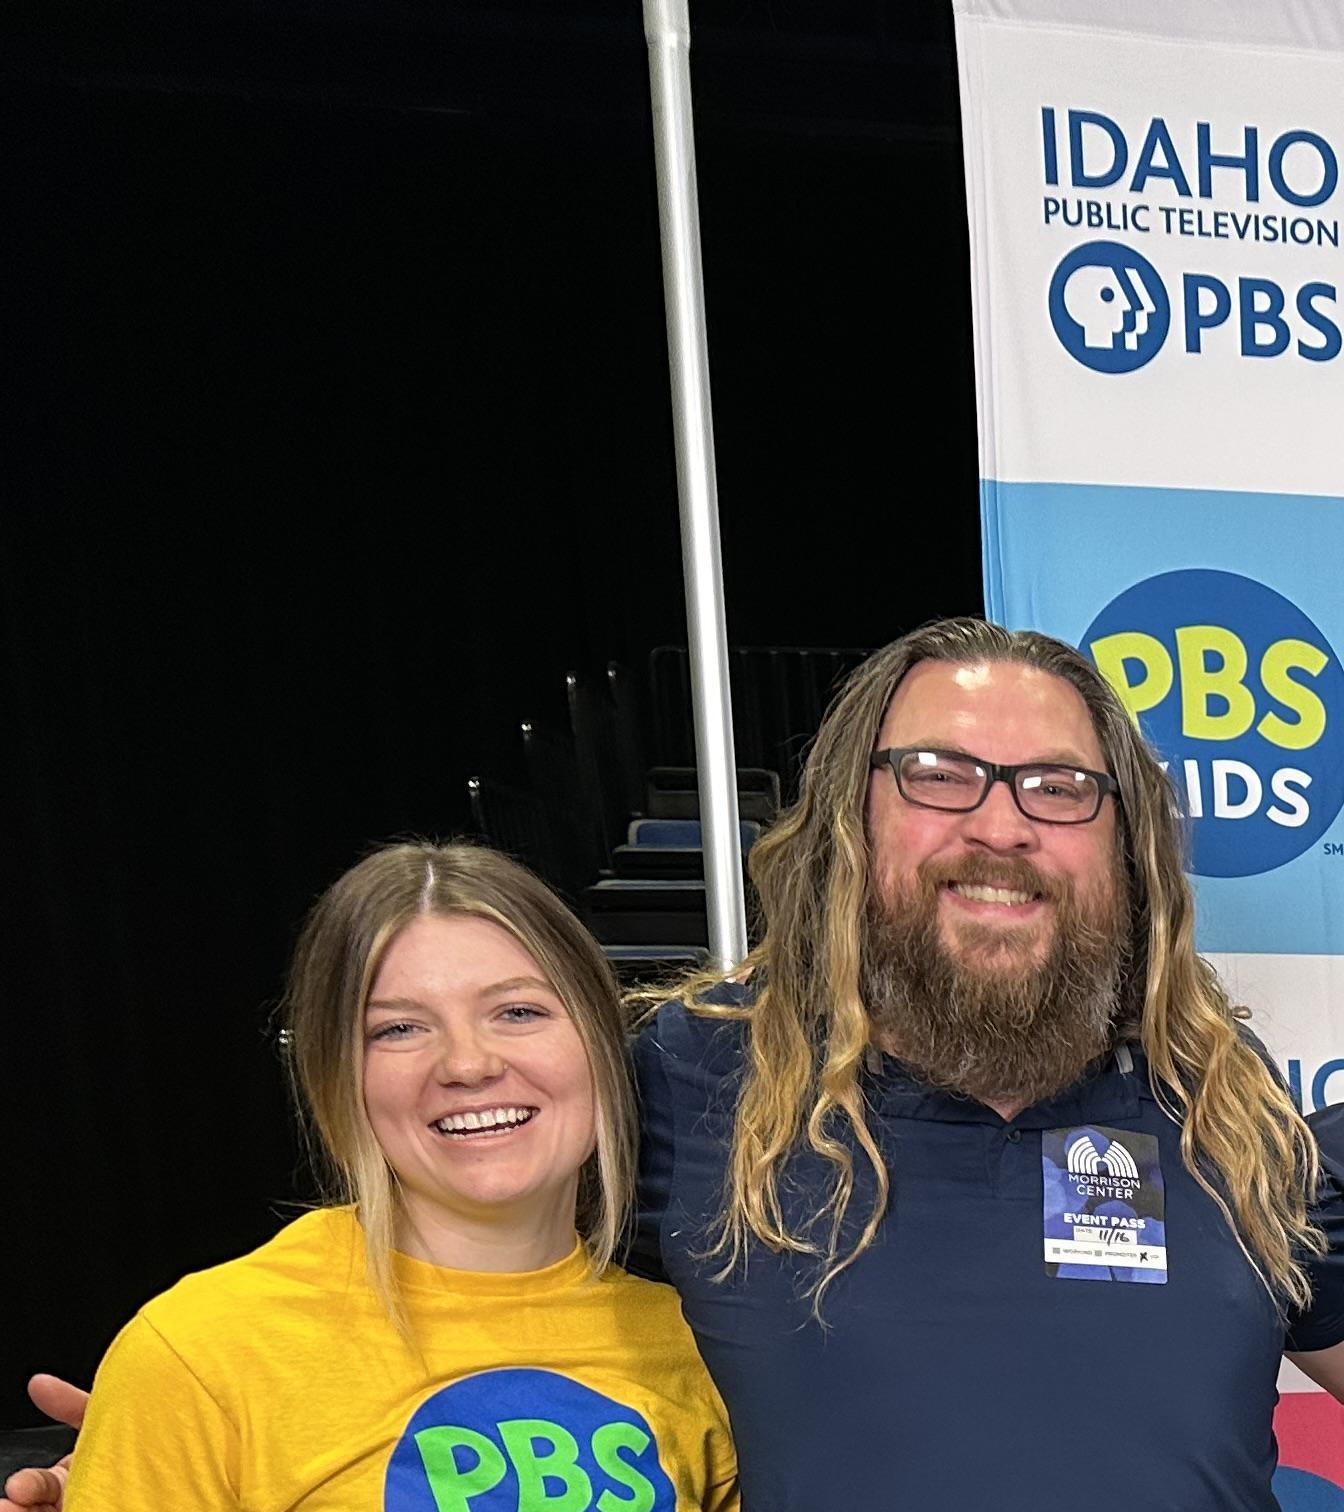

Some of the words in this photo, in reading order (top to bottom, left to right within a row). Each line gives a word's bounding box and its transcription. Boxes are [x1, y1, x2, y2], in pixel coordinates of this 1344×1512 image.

[1039, 106, 1339, 208] IDAHO
[1043, 197, 1151, 235] PUBLIC
[1158, 206, 1339, 249] TELEVISION
[1184, 272, 1343, 363] PBS
[1090, 625, 1329, 750] PBS
[1160, 759, 1313, 827] IDS
[1323, 843, 1344, 855] SM
[1068, 1174, 1141, 1190] MORRISON
[1077, 1185, 1134, 1200] CENTER
[1063, 1213, 1108, 1226] EVENT
[1111, 1217, 1146, 1229] PASS
[1099, 1226, 1130, 1246] 11/16
